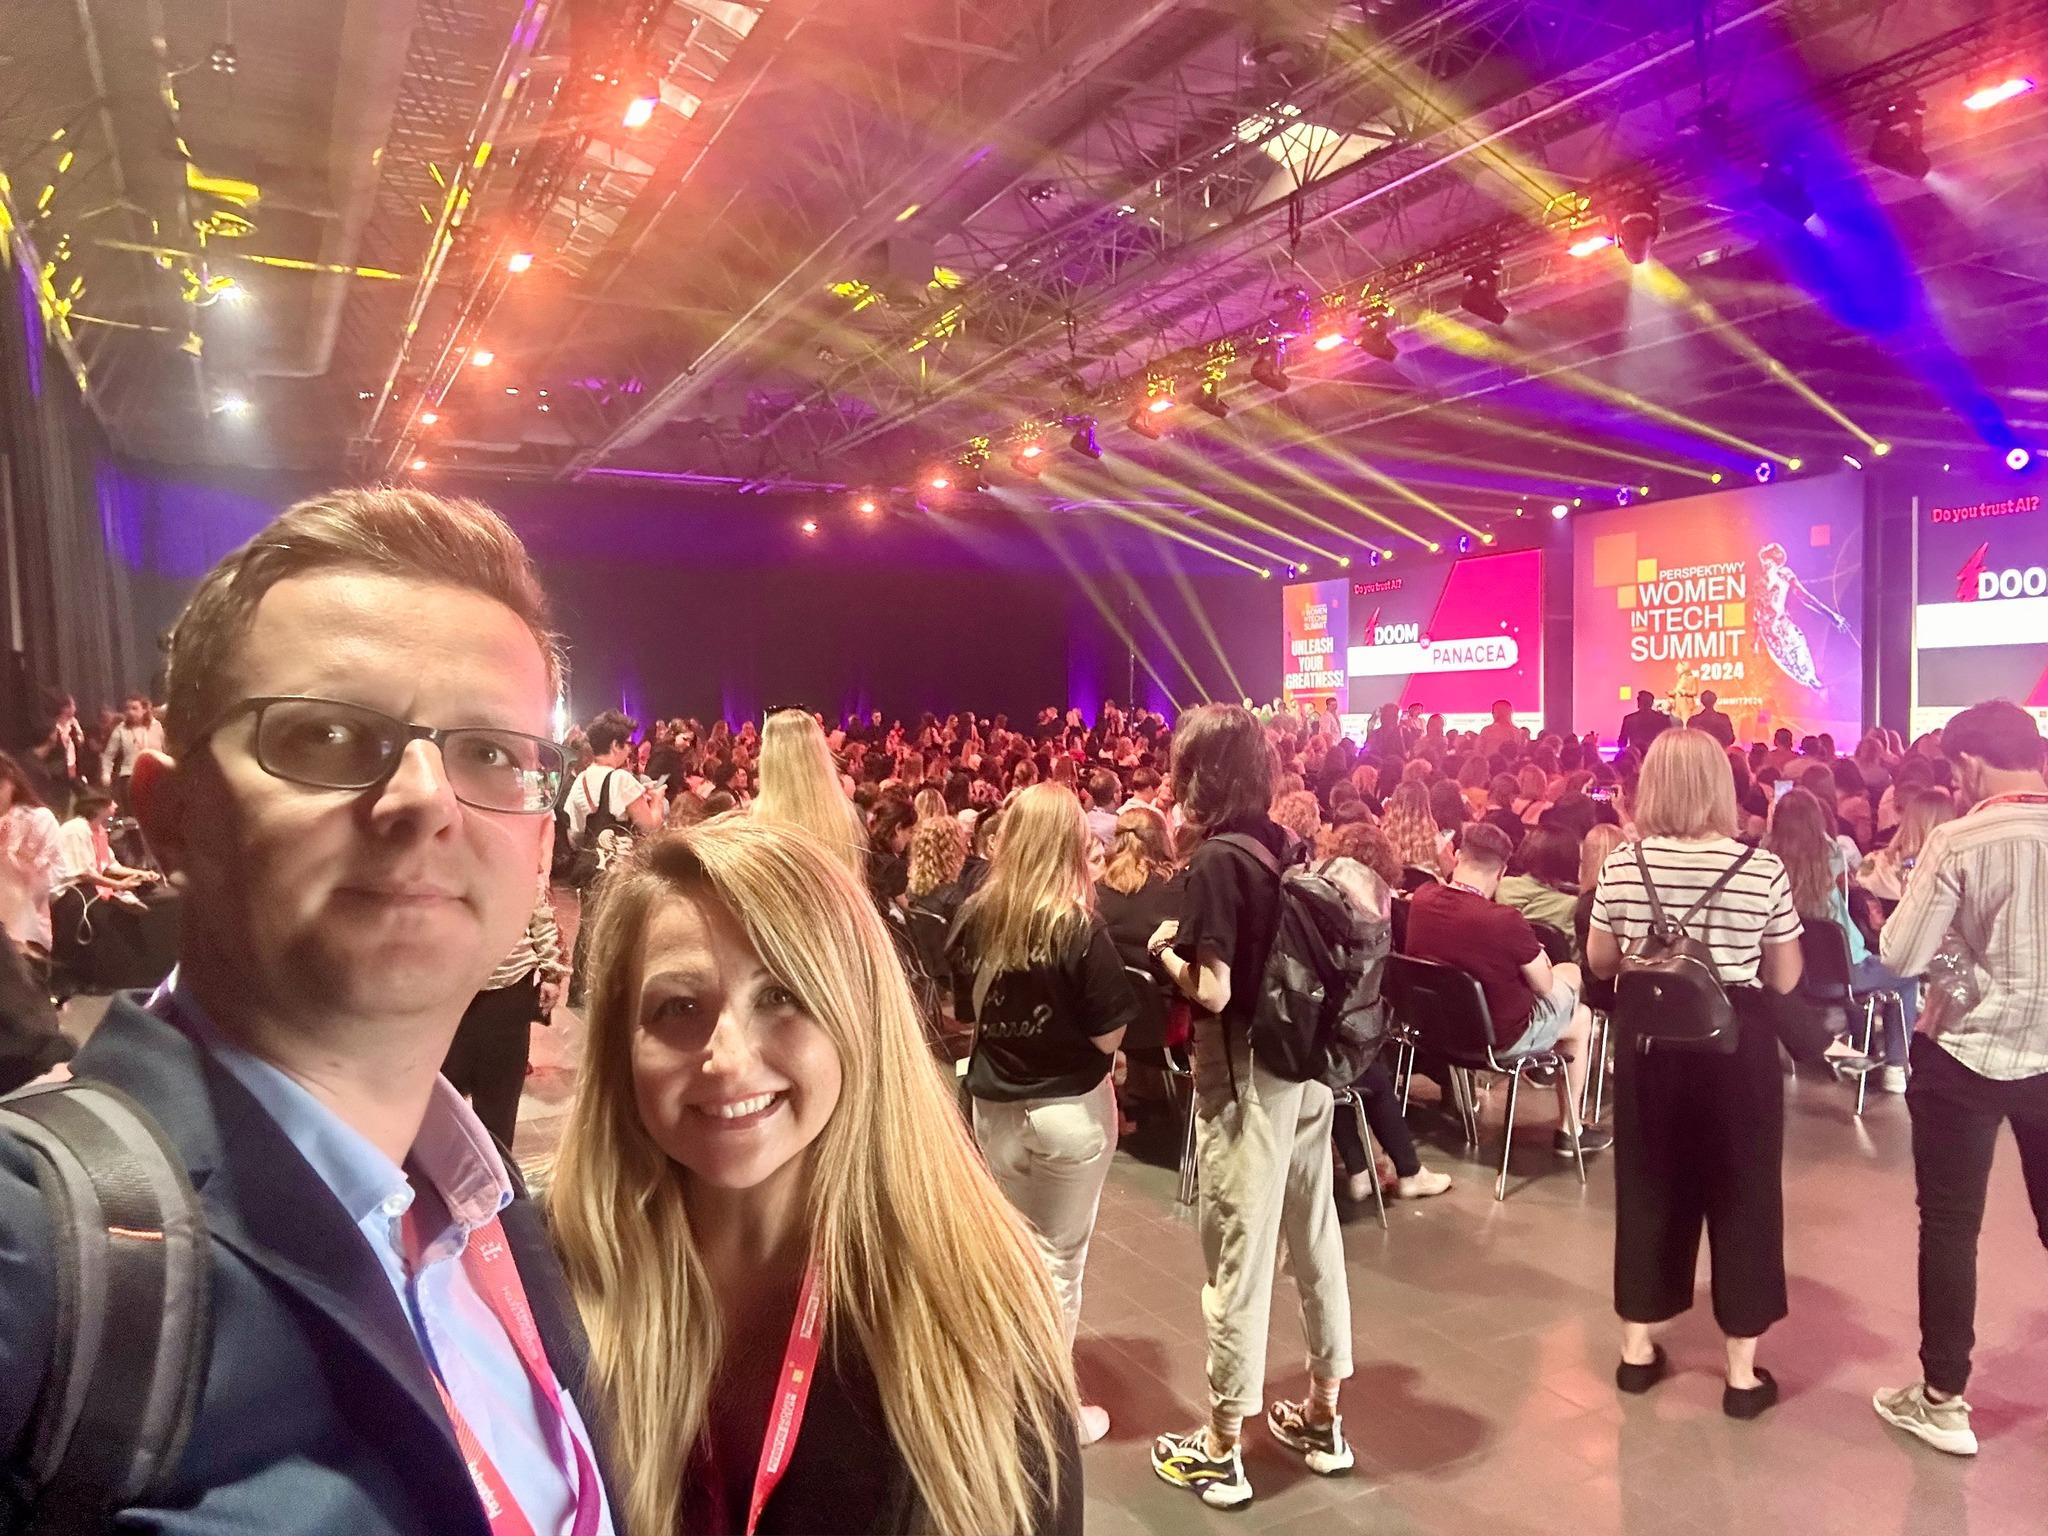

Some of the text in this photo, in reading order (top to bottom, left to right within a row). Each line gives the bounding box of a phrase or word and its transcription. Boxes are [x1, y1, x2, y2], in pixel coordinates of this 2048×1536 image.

[1932, 496, 2039, 522] Do you trust AI?
[1659, 561, 1745, 580] PERSPEKTYWY
[1639, 574, 1746, 607] WOMEN
[1978, 566, 2048, 599] DOO
[1631, 604, 1722, 633] IN TECH
[1374, 623, 1419, 645] DOOM
[1291, 636, 1334, 656] UNLEASH
[1433, 644, 1506, 664] PANACEA
[1631, 630, 1746, 661] SUMMIT
[1298, 655, 1324, 672] YOUR
[1700, 661, 1744, 680] 2024
[1285, 669, 1345, 690] GREATNESS!
